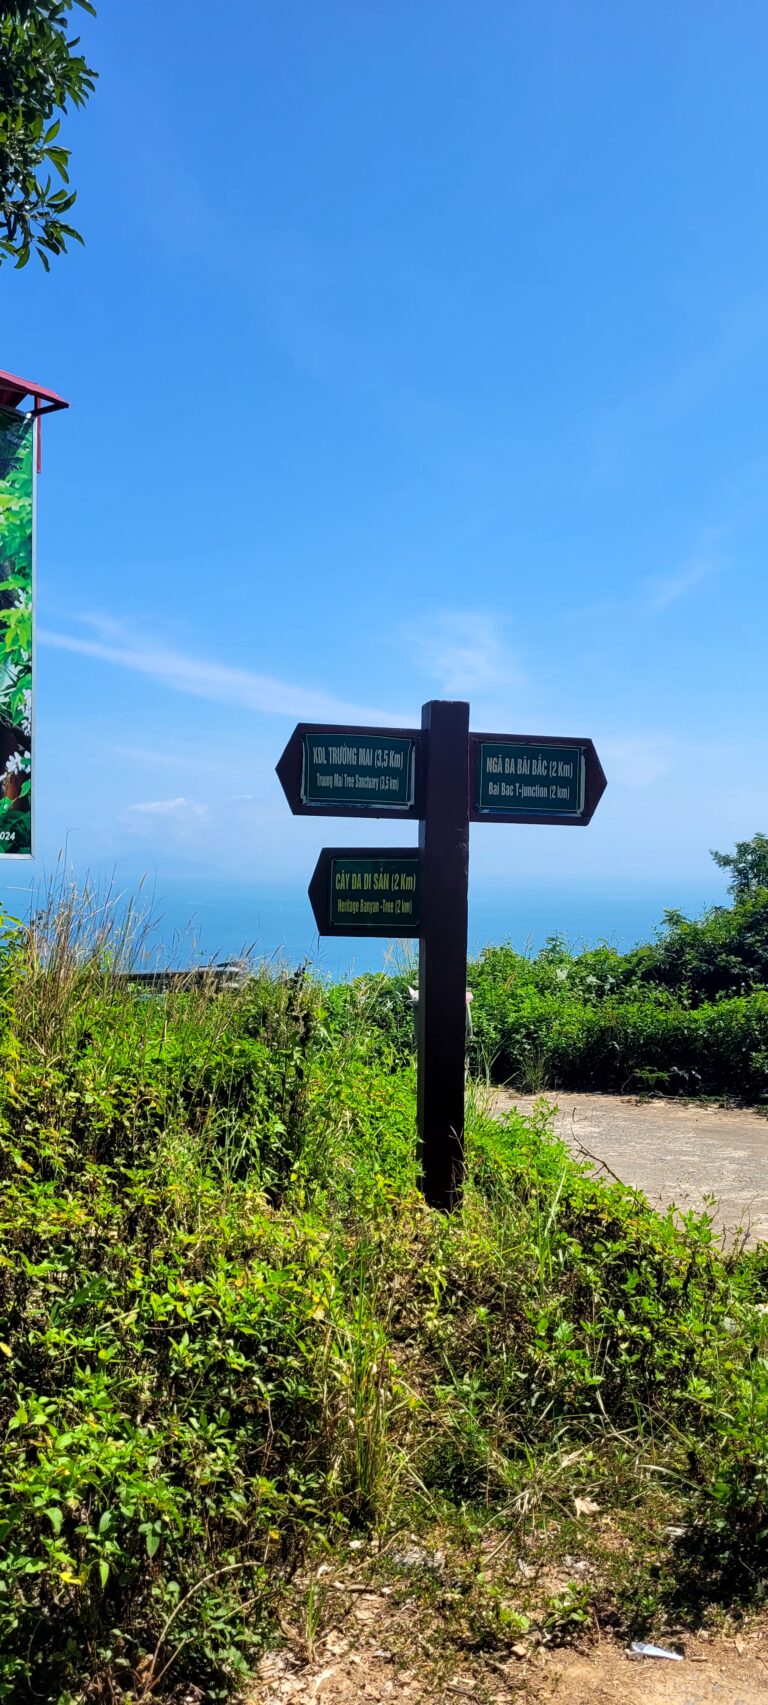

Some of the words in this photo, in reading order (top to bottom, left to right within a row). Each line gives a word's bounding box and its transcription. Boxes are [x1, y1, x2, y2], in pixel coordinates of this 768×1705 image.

[328, 743, 357, 765] TRƯỜNG
[359, 748, 373, 766] MAI
[374, 749, 388, 768] (3,5
[389, 750, 404, 770] Km)
[486, 754, 503, 774] NGÃ
[505, 758, 515, 774] BA
[517, 756, 530, 775] BÃI
[550, 760, 557, 778] (2
[558, 761, 573, 779] Km)
[334, 773, 343, 788] Mai
[344, 774, 355, 788] Tree
[356, 774, 379, 790] Sanctuary
[390, 776, 399, 792] km)
[489, 782, 500, 795] Bai
[501, 782, 513, 796] Bac
[516, 783, 547, 798] T-junction
[550, 785, 556, 799] (2
[557, 785, 569, 800] km)
[363, 873, 372, 890] DI
[391, 874, 399, 891] (2
[400, 874, 416, 892] Km)
[338, 899, 359, 914] Heritage
[360, 899, 379, 914] Banyan
[395, 899, 400, 914] (2
[402, 899, 412, 914] km)
